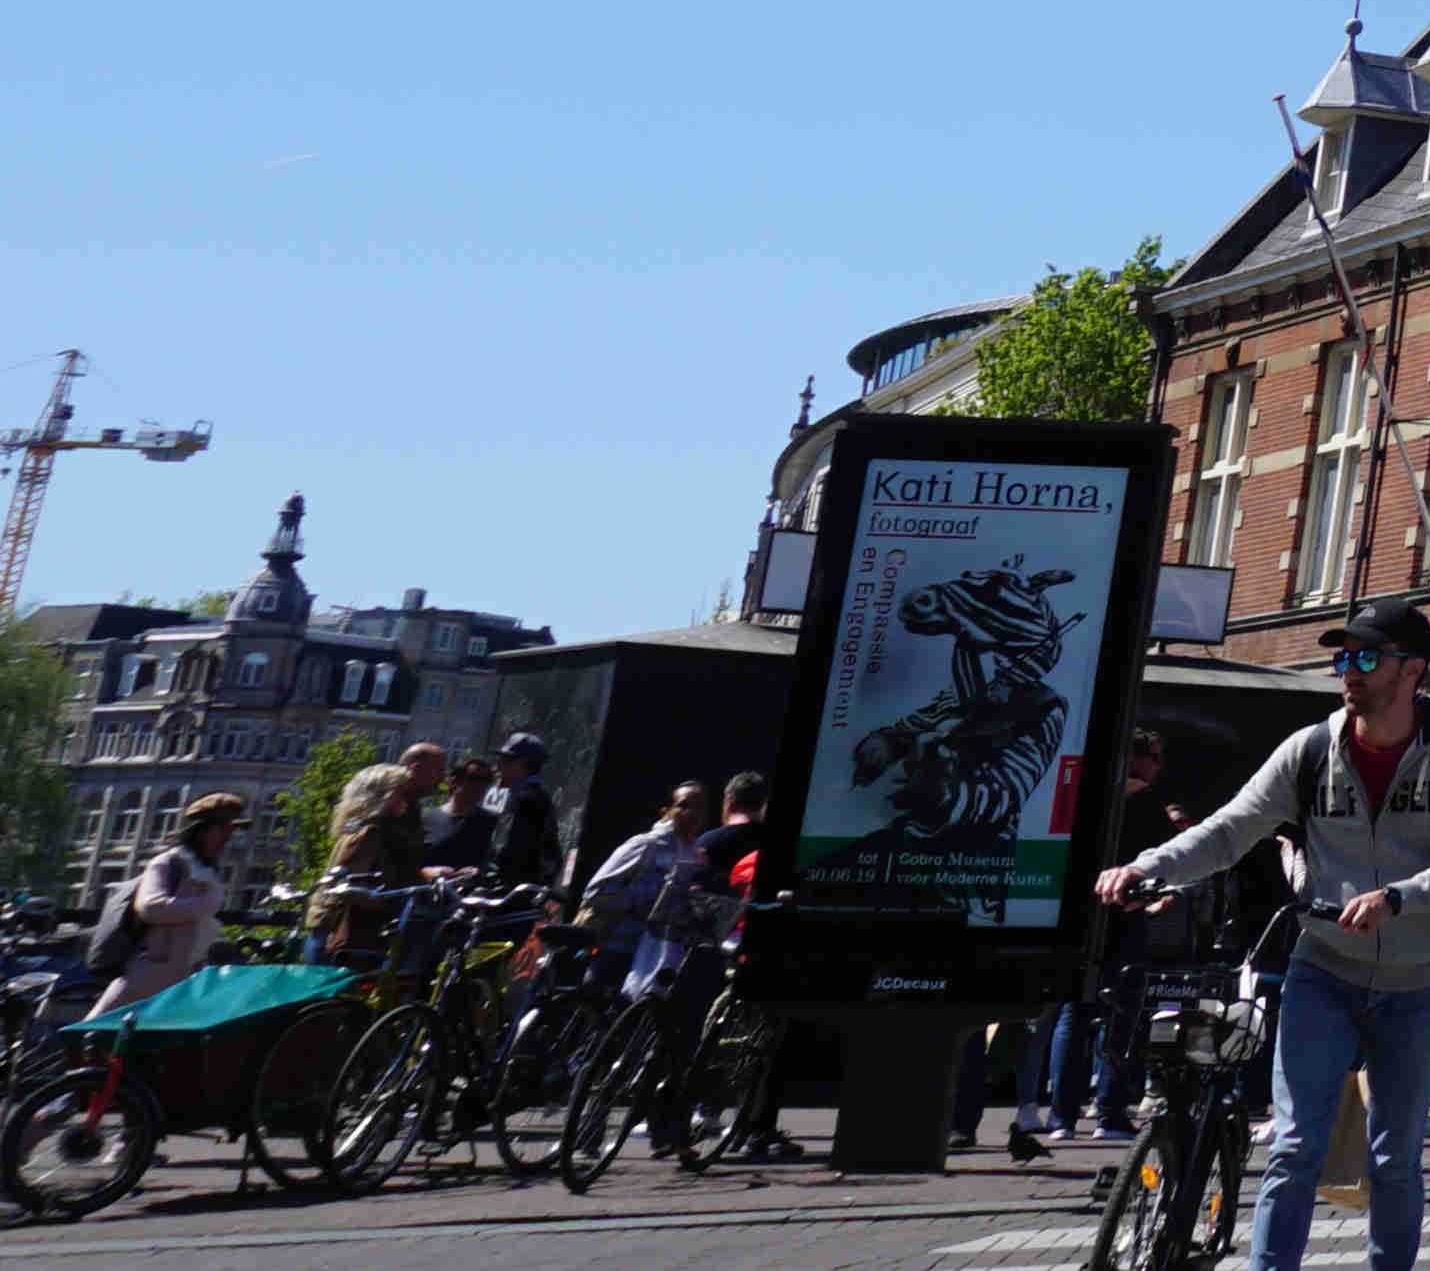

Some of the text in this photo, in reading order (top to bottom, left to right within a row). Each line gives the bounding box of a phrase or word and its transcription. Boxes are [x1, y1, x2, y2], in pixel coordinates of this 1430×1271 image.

[872, 470, 1114, 515] Kati Horna,
[869, 512, 980, 538] fotograaf
[860, 546, 878, 574] en
[867, 548, 906, 674] Compassie
[857, 852, 878, 865] tot
[934, 871, 998, 885] Moderne
[871, 976, 948, 990] JCDecaux
